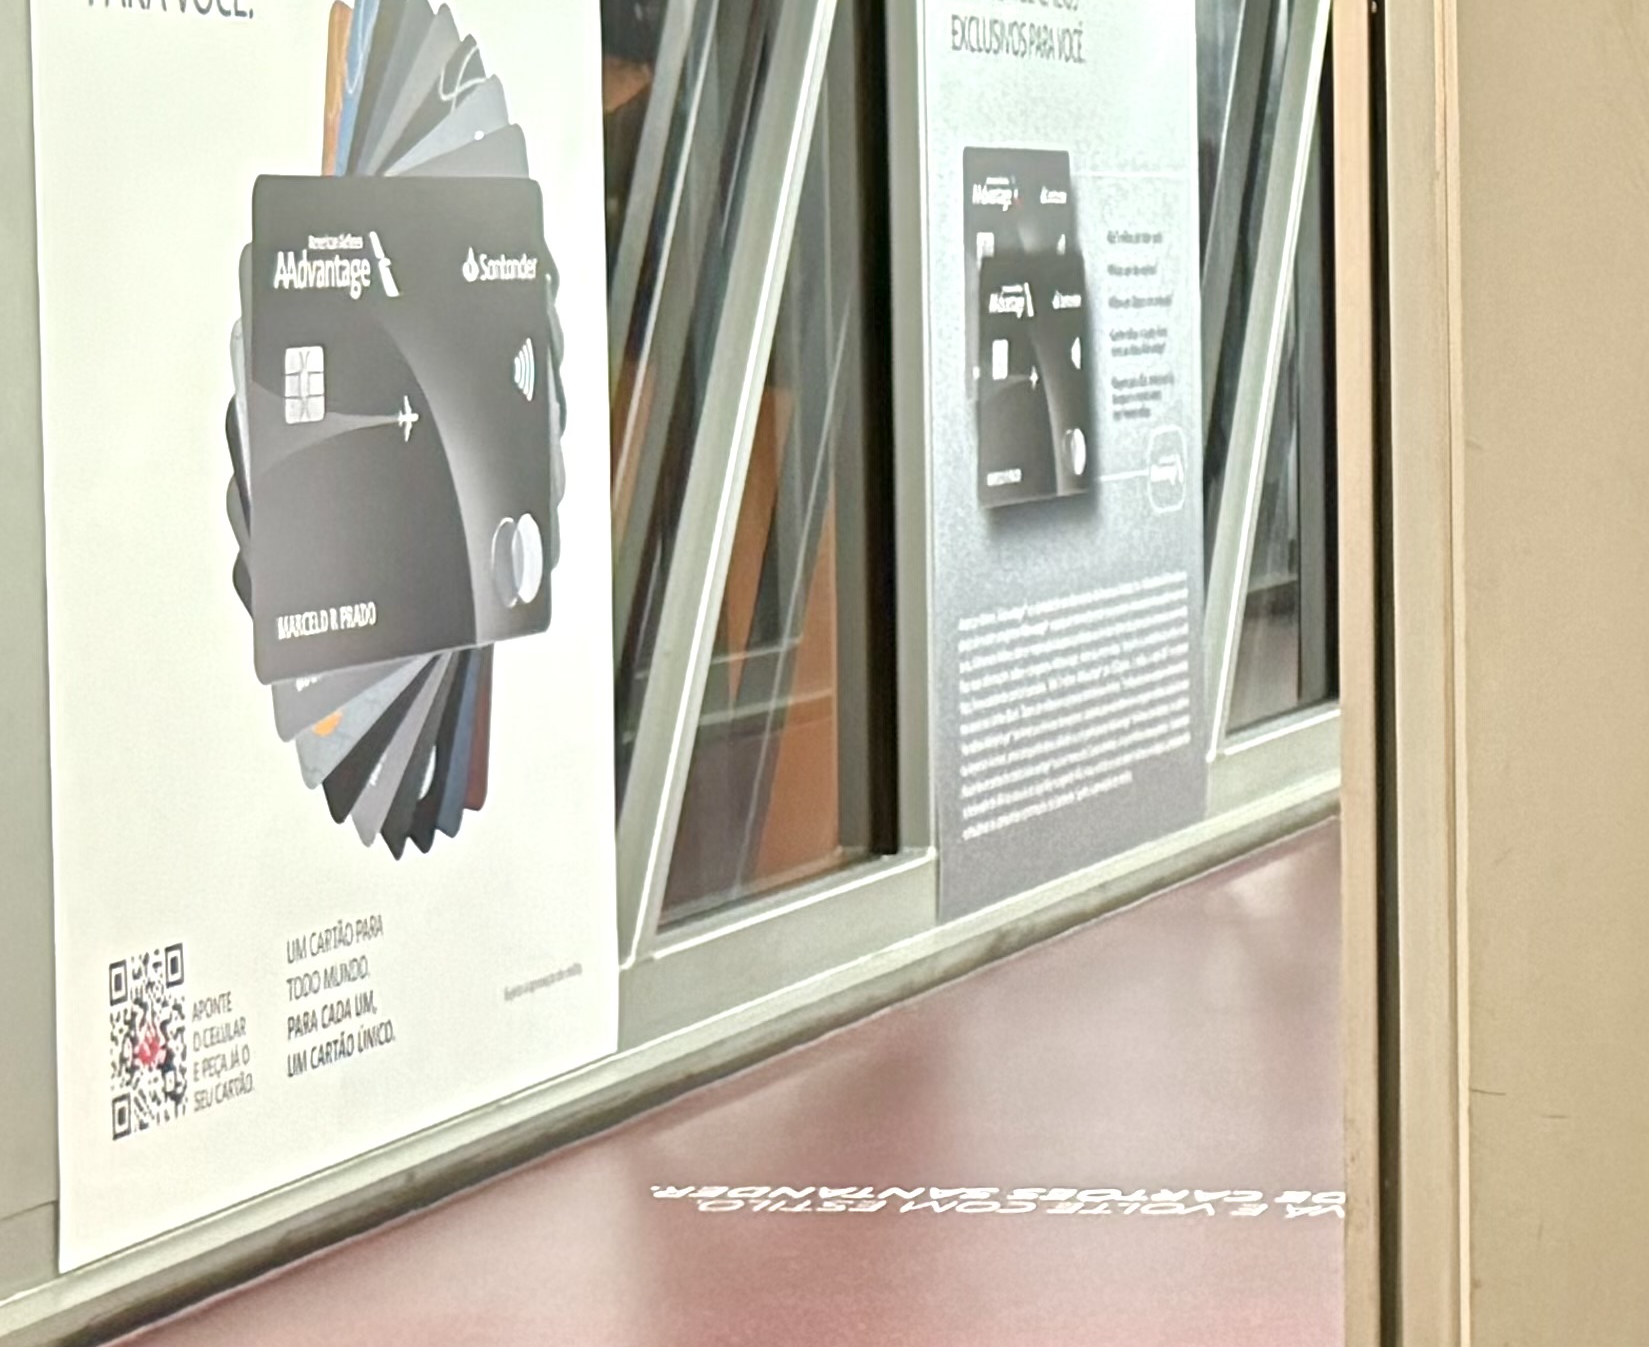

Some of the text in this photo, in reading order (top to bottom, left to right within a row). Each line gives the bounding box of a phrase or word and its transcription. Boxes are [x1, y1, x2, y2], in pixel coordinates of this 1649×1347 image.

[951, 14, 1026, 58] EXCLUSIVOS
[1029, 22, 1055, 60] PARA
[274, 249, 371, 300] AAdvantage
[479, 252, 537, 282] Santander
[287, 914, 384, 964] UM CARTÃO PARA
[286, 970, 321, 1002] TODO
[192, 991, 232, 1022] APONTE
[288, 1009, 318, 1041] PARA
[321, 998, 352, 1029] CADA
[203, 1016, 246, 1048] CELULAR
[287, 1050, 307, 1077] UM
[310, 1031, 355, 1070] CARTÃO
[193, 1088, 213, 1113] SEU
[899, 1201, 1036, 1214] COM
[1046, 1202, 1215, 1217] VOLTE
